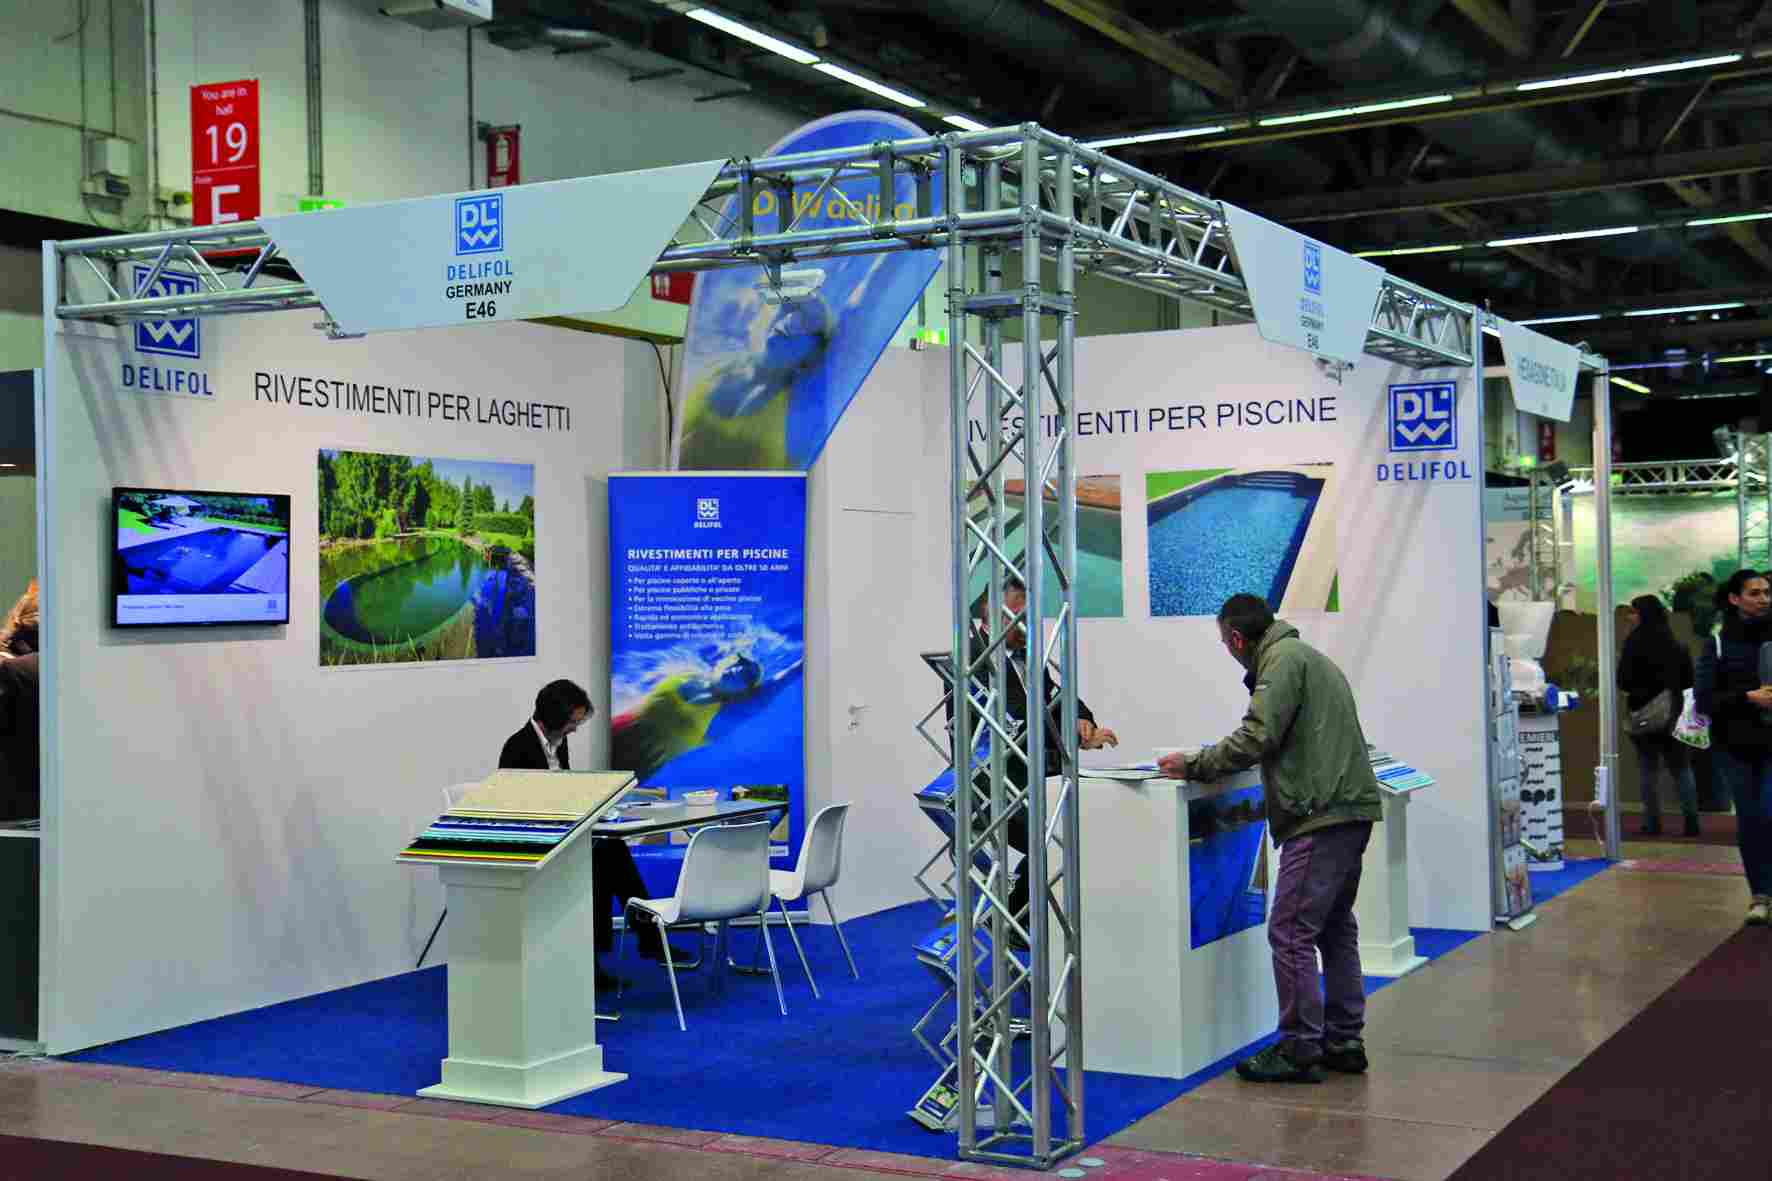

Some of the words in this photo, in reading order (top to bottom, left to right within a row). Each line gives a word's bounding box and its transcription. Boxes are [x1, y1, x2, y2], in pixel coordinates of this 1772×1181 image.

[216, 103, 233, 116] hall
[206, 122, 248, 164] 19
[752, 191, 825, 219] DW
[447, 259, 513, 281] DELIFOL
[446, 280, 512, 299] GERMANY
[466, 301, 496, 319] E46
[122, 364, 212, 396] DELIFOL
[254, 372, 421, 417] RIVESTIMENTI
[428, 392, 471, 422] PER
[477, 397, 571, 431] LAGHETTI
[1149, 404, 1207, 432] PER
[1216, 397, 1337, 427] PISCINE
[1376, 461, 1472, 480] DELIFOL
[628, 548, 713, 560] RIVESTIMENTI
[717, 548, 738, 560] PER
[743, 548, 789, 560] PISCINE
